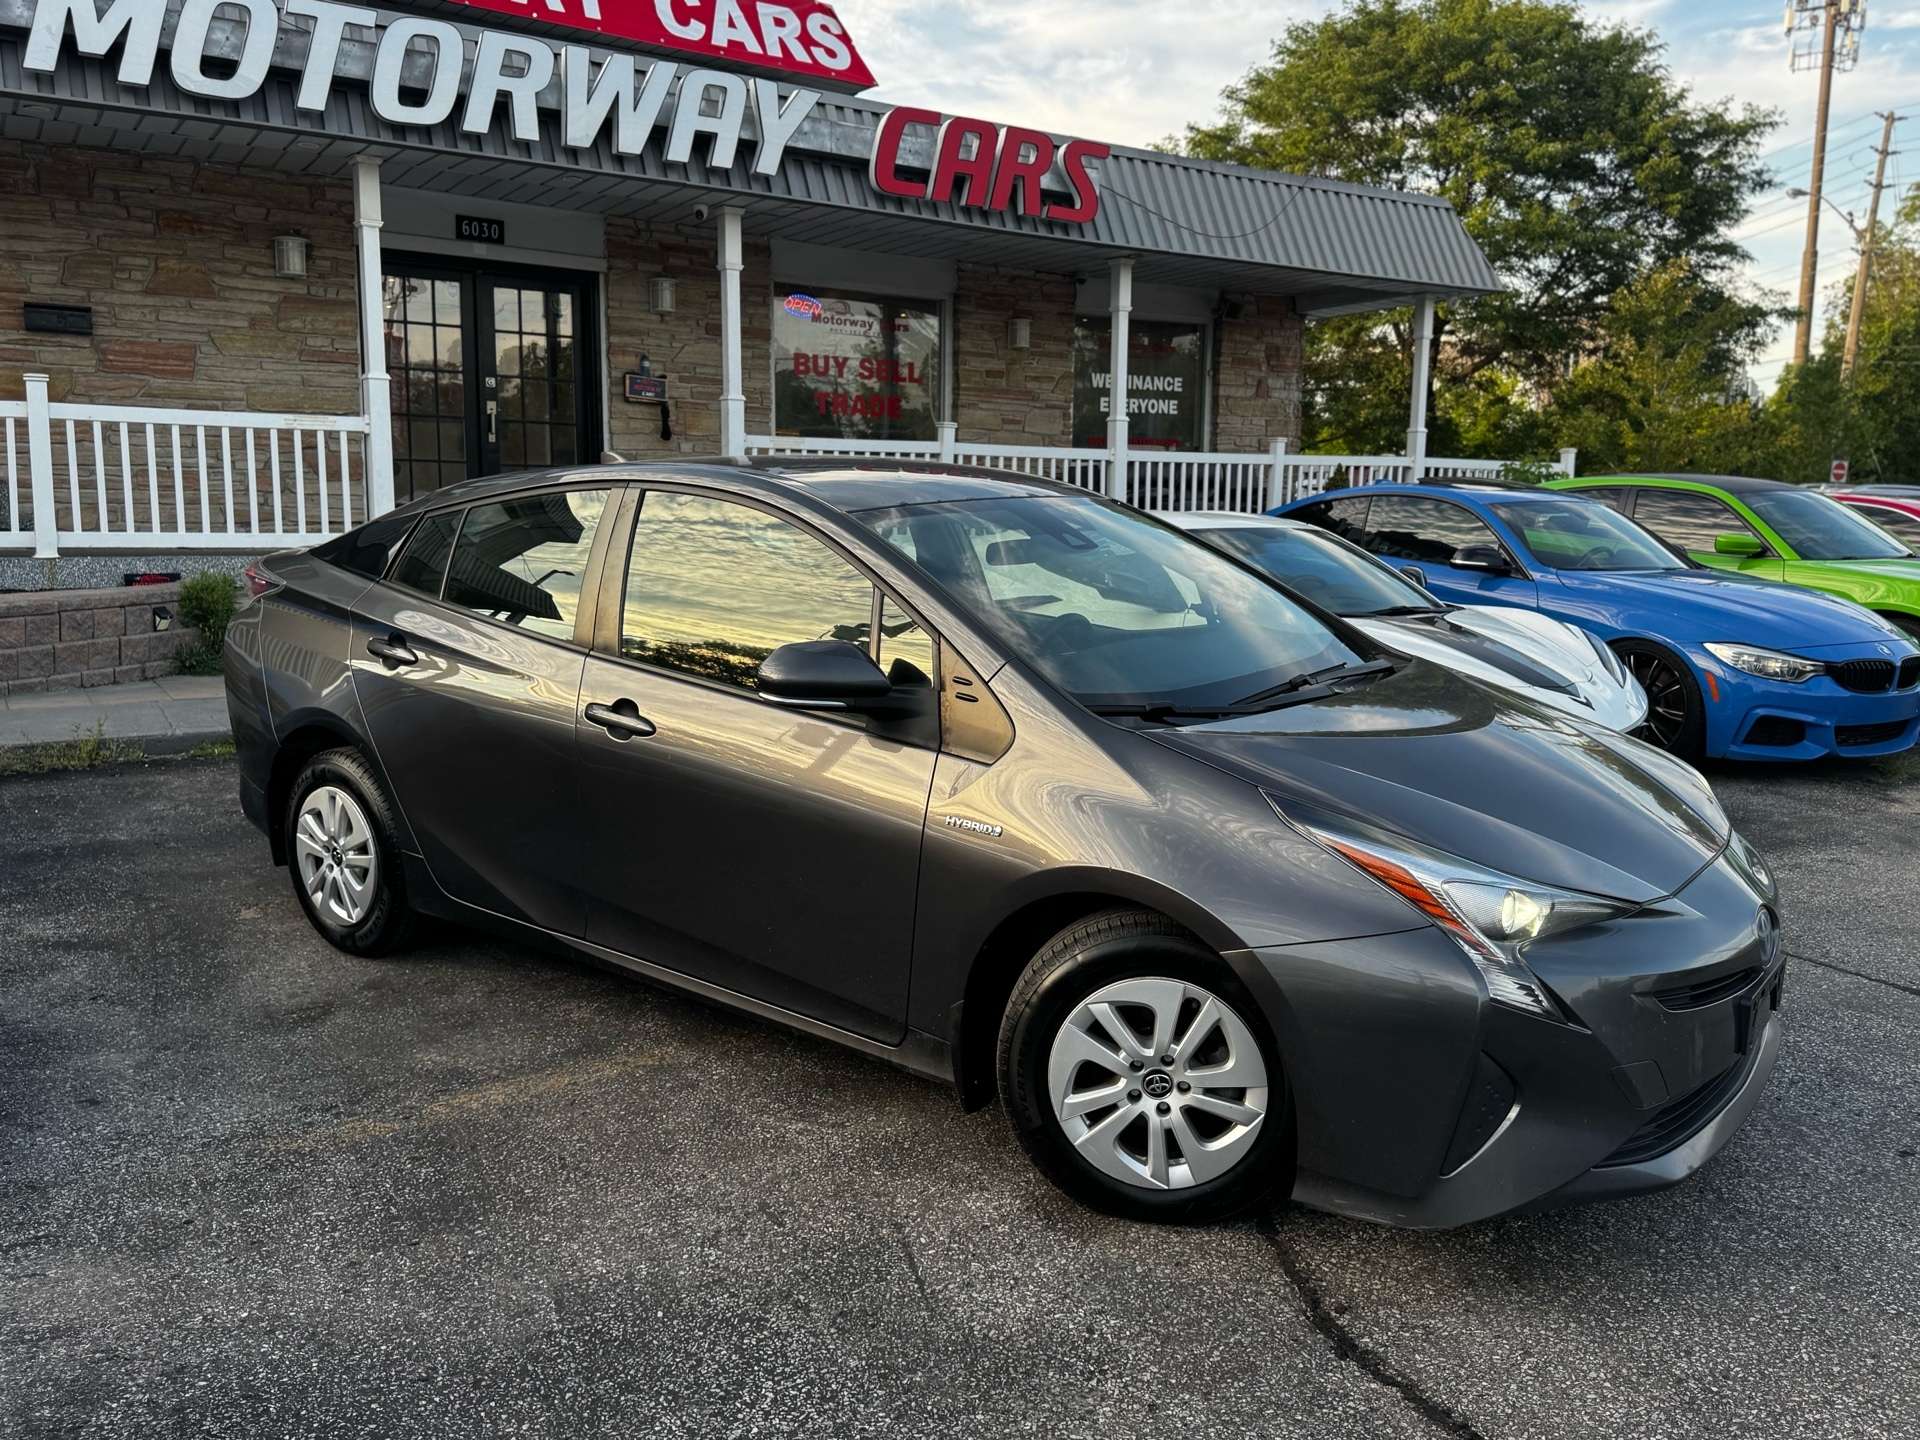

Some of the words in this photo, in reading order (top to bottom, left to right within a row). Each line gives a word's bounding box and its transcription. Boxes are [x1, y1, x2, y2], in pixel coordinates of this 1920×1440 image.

[654, 0, 852, 71] CARS
[23, 0, 822, 177] MOTORWAY
[869, 106, 1111, 224] CARS
[462, 220, 499, 239] 6030
[784, 296, 822, 314] OPEN
[811, 313, 874, 330] Motorway
[793, 352, 849, 378] BUY
[859, 357, 922, 384] SELL
[1128, 374, 1182, 392] INANCE
[816, 391, 902, 418] TRADE
[1100, 397, 1178, 414] ERYONE
[945, 816, 993, 834] HYBRID
